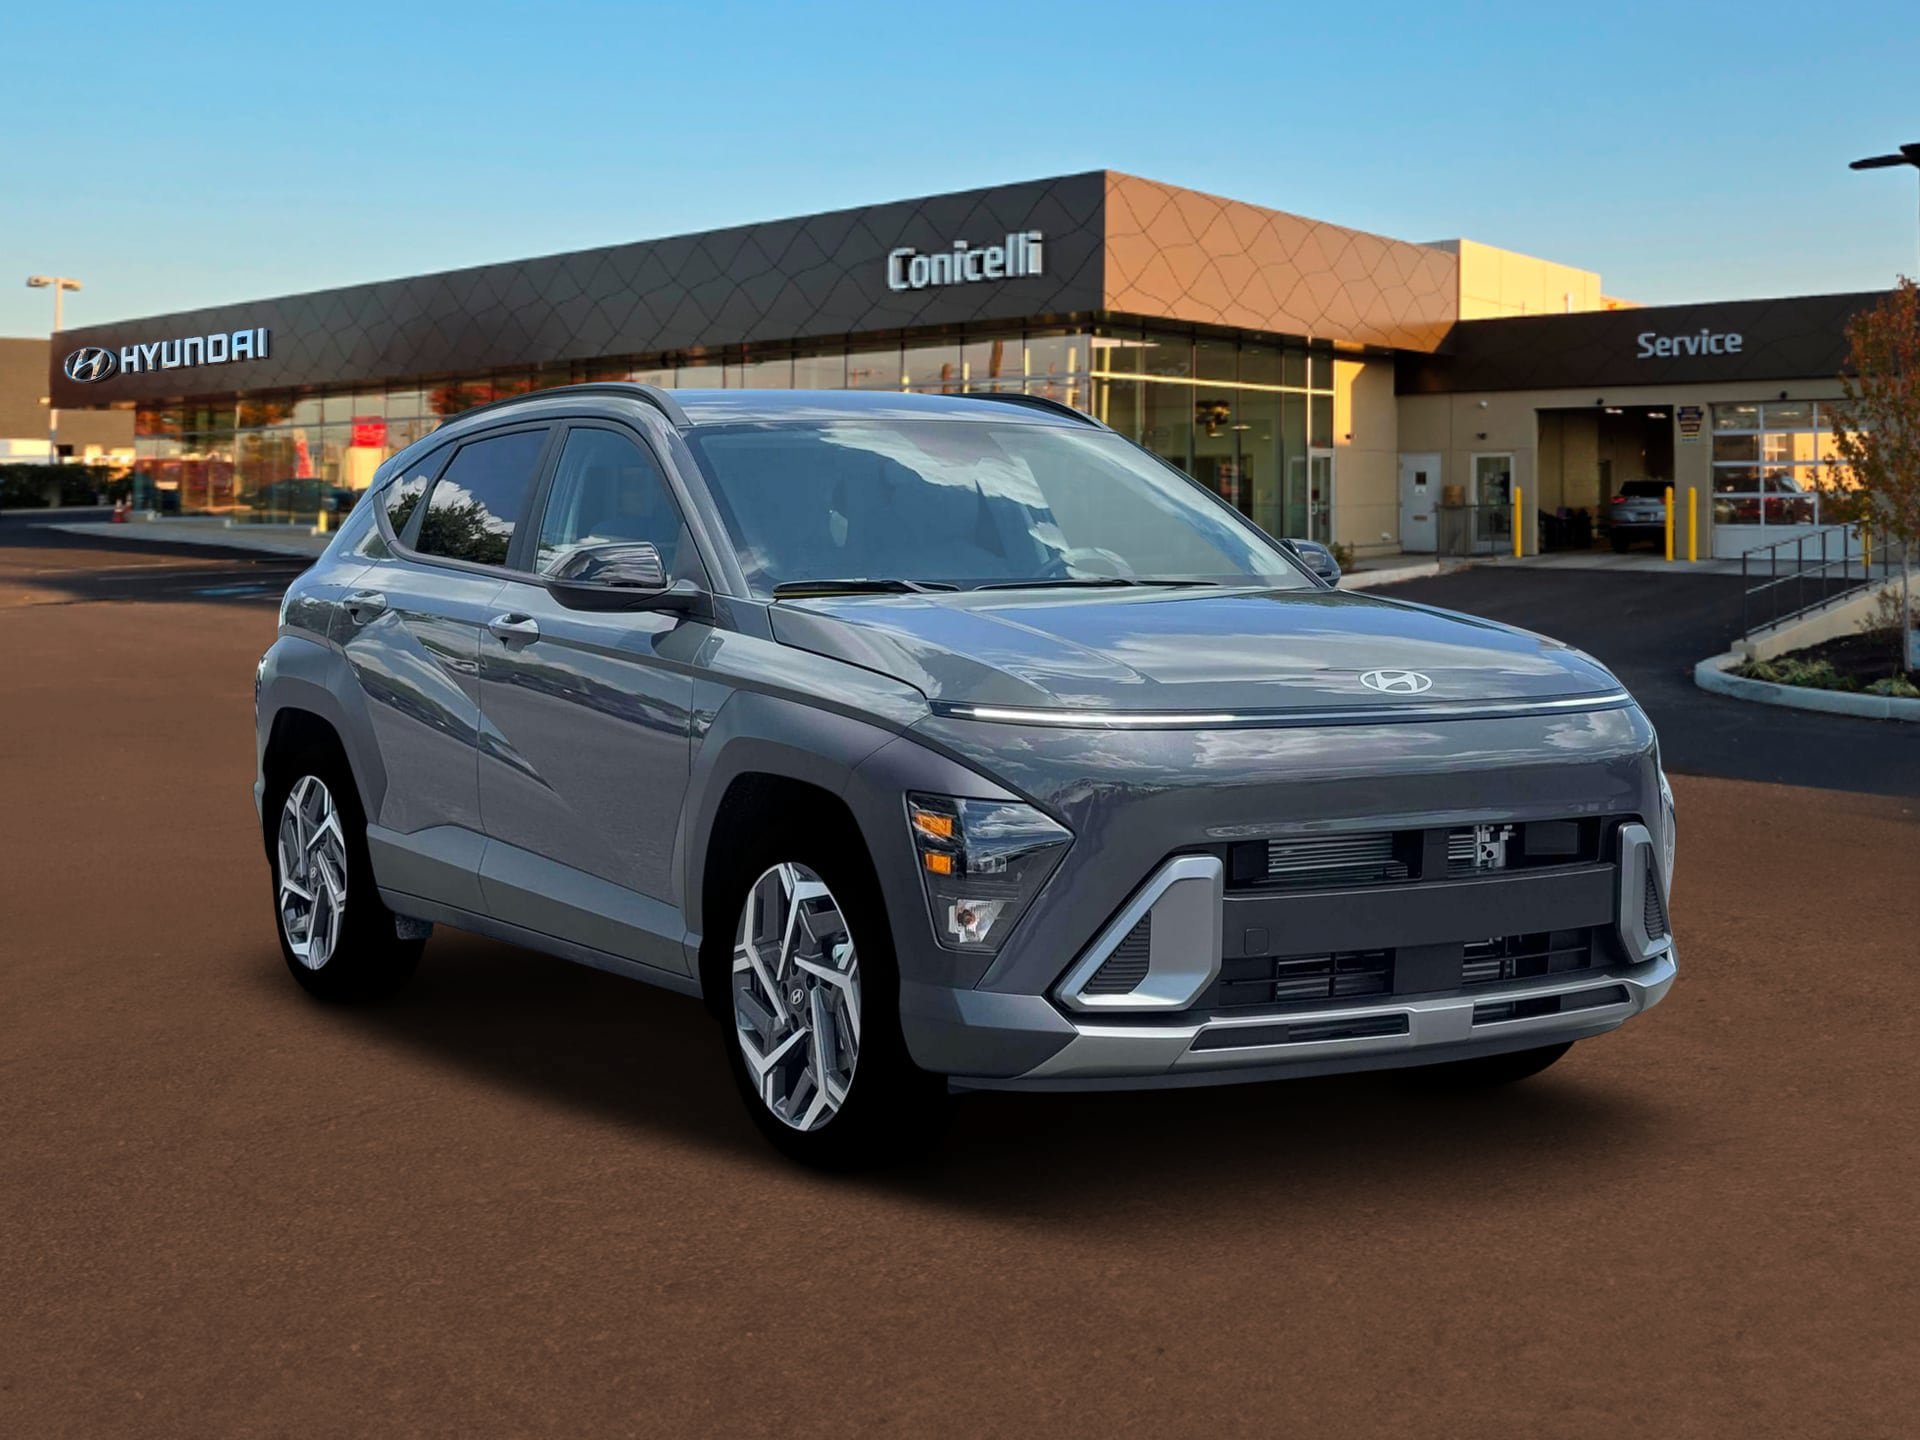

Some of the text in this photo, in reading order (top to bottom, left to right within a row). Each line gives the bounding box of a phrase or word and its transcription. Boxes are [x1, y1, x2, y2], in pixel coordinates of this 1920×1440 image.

[888, 231, 1042, 290] Conicelli
[121, 328, 268, 373] HYUNDAI
[1637, 328, 1742, 358] Service
